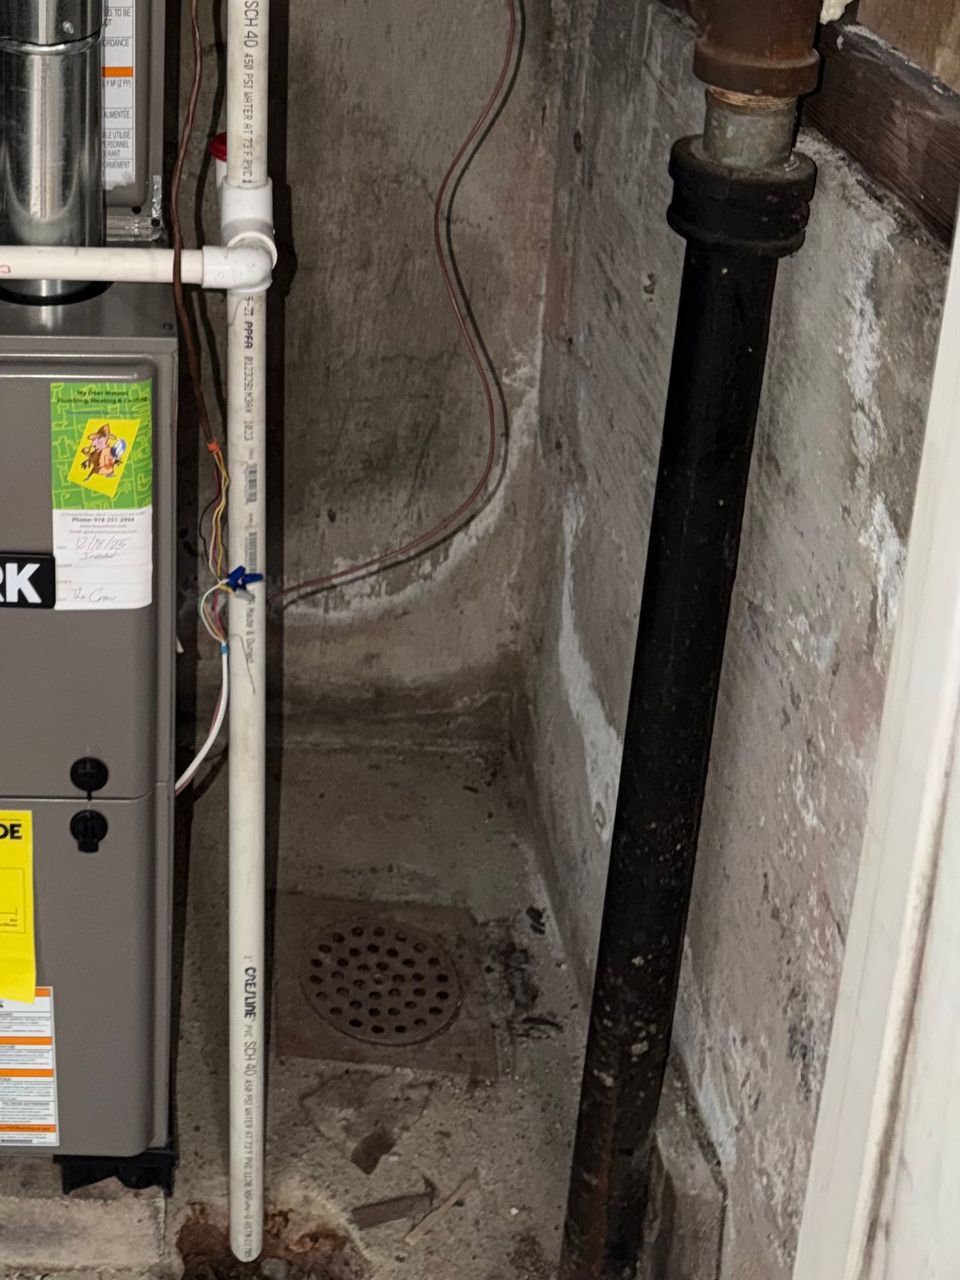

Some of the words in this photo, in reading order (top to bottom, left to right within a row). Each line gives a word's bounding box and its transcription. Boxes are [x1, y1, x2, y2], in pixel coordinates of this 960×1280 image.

[243, 0, 259, 27] SCH
[243, 31, 259, 48] 40
[243, 73, 253, 89] PSI
[243, 91, 253, 120] WATER
[243, 123, 253, 134] AT
[244, 320, 254, 349] PPFA
[243, 1040, 257, 1061] SCH
[243, 1063, 257, 1076] 40
